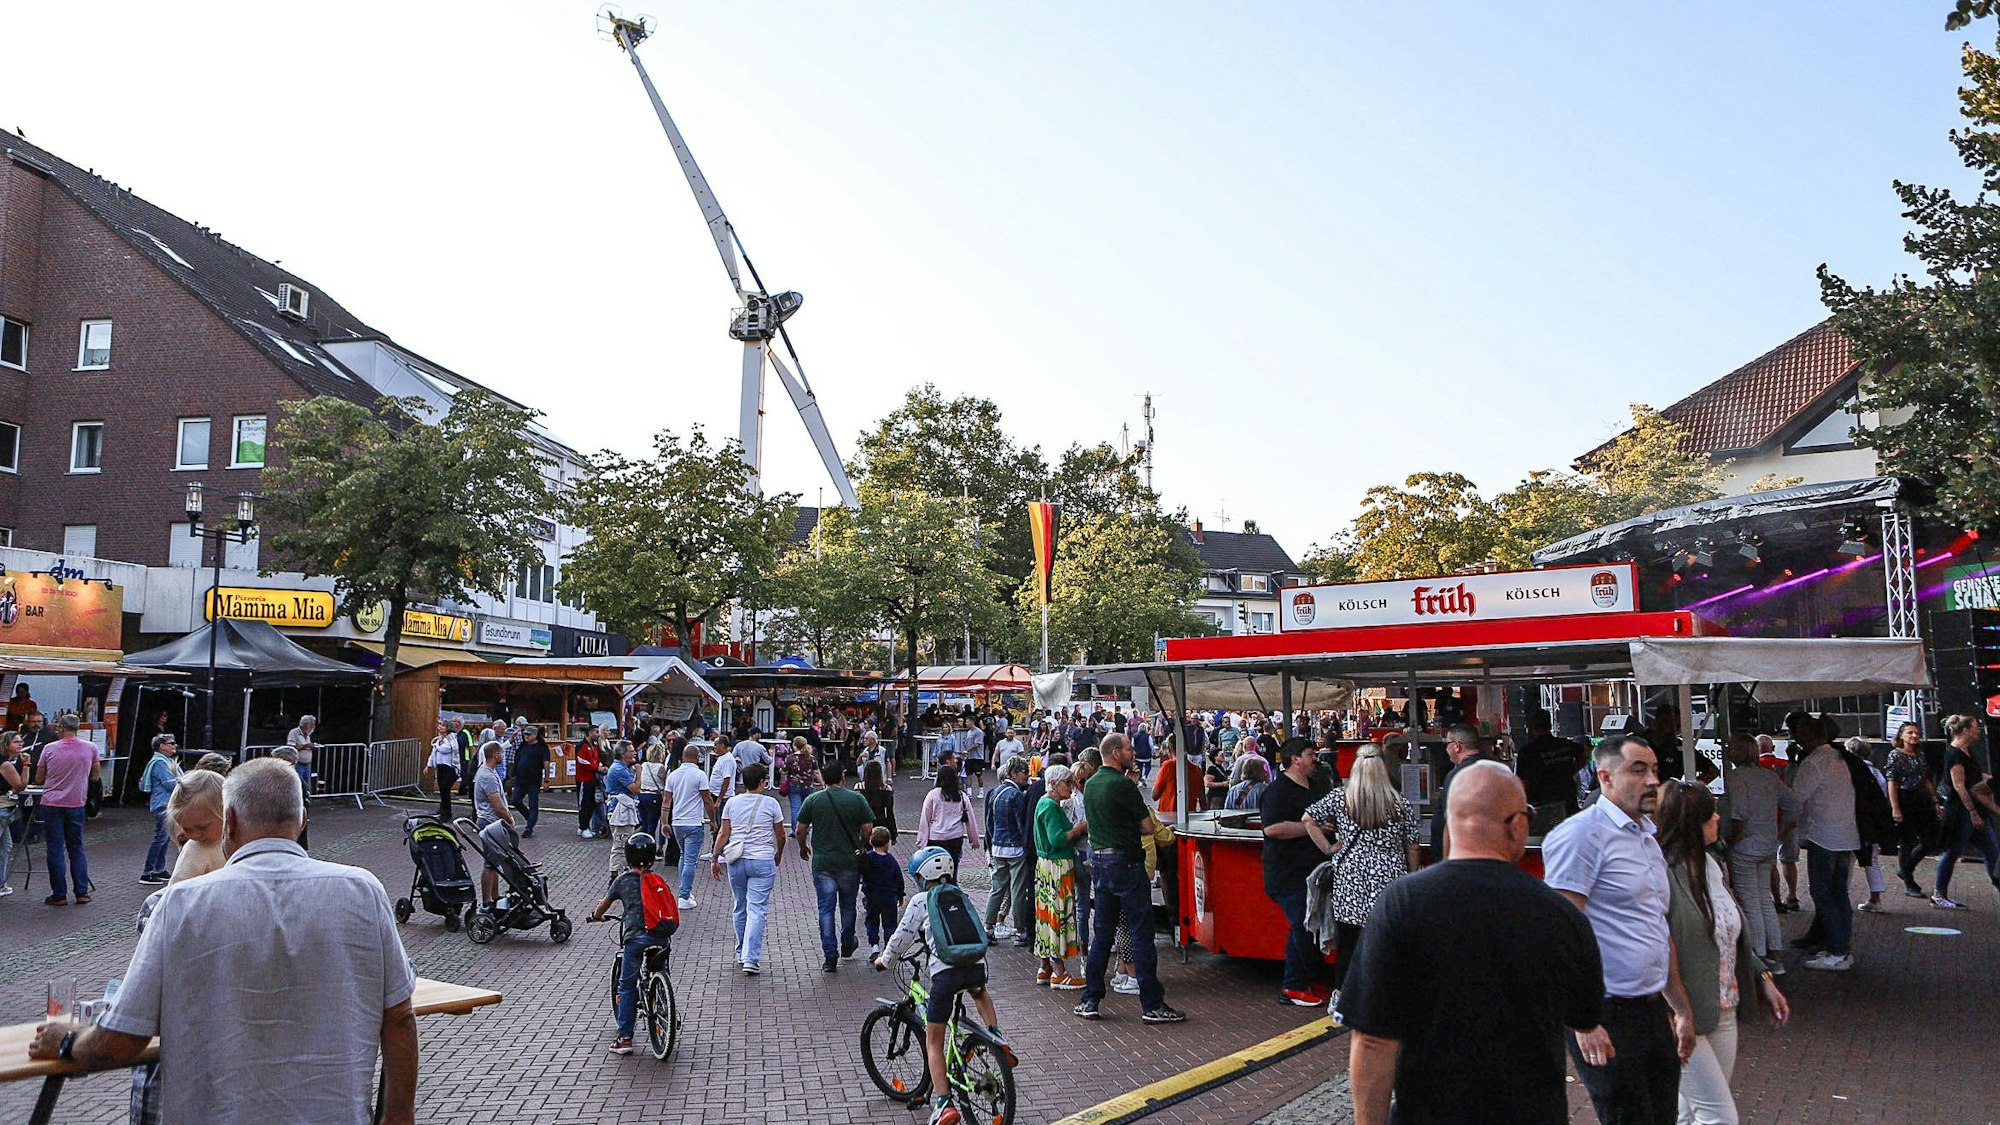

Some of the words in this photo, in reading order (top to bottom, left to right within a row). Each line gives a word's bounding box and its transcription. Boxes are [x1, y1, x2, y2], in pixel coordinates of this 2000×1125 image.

[49, 559, 84, 580] dm
[216, 594, 287, 619] Mamma
[292, 597, 325, 620] Mia
[235, 594, 266, 602] Pizzeria
[1339, 599, 1387, 611] KÖLSCH
[1411, 582, 1477, 617] früh
[1506, 587, 1560, 601] KÖLSCH
[25, 605, 44, 618] BAR
[433, 616, 447, 637] Mia
[577, 636, 610, 656] JULIA
